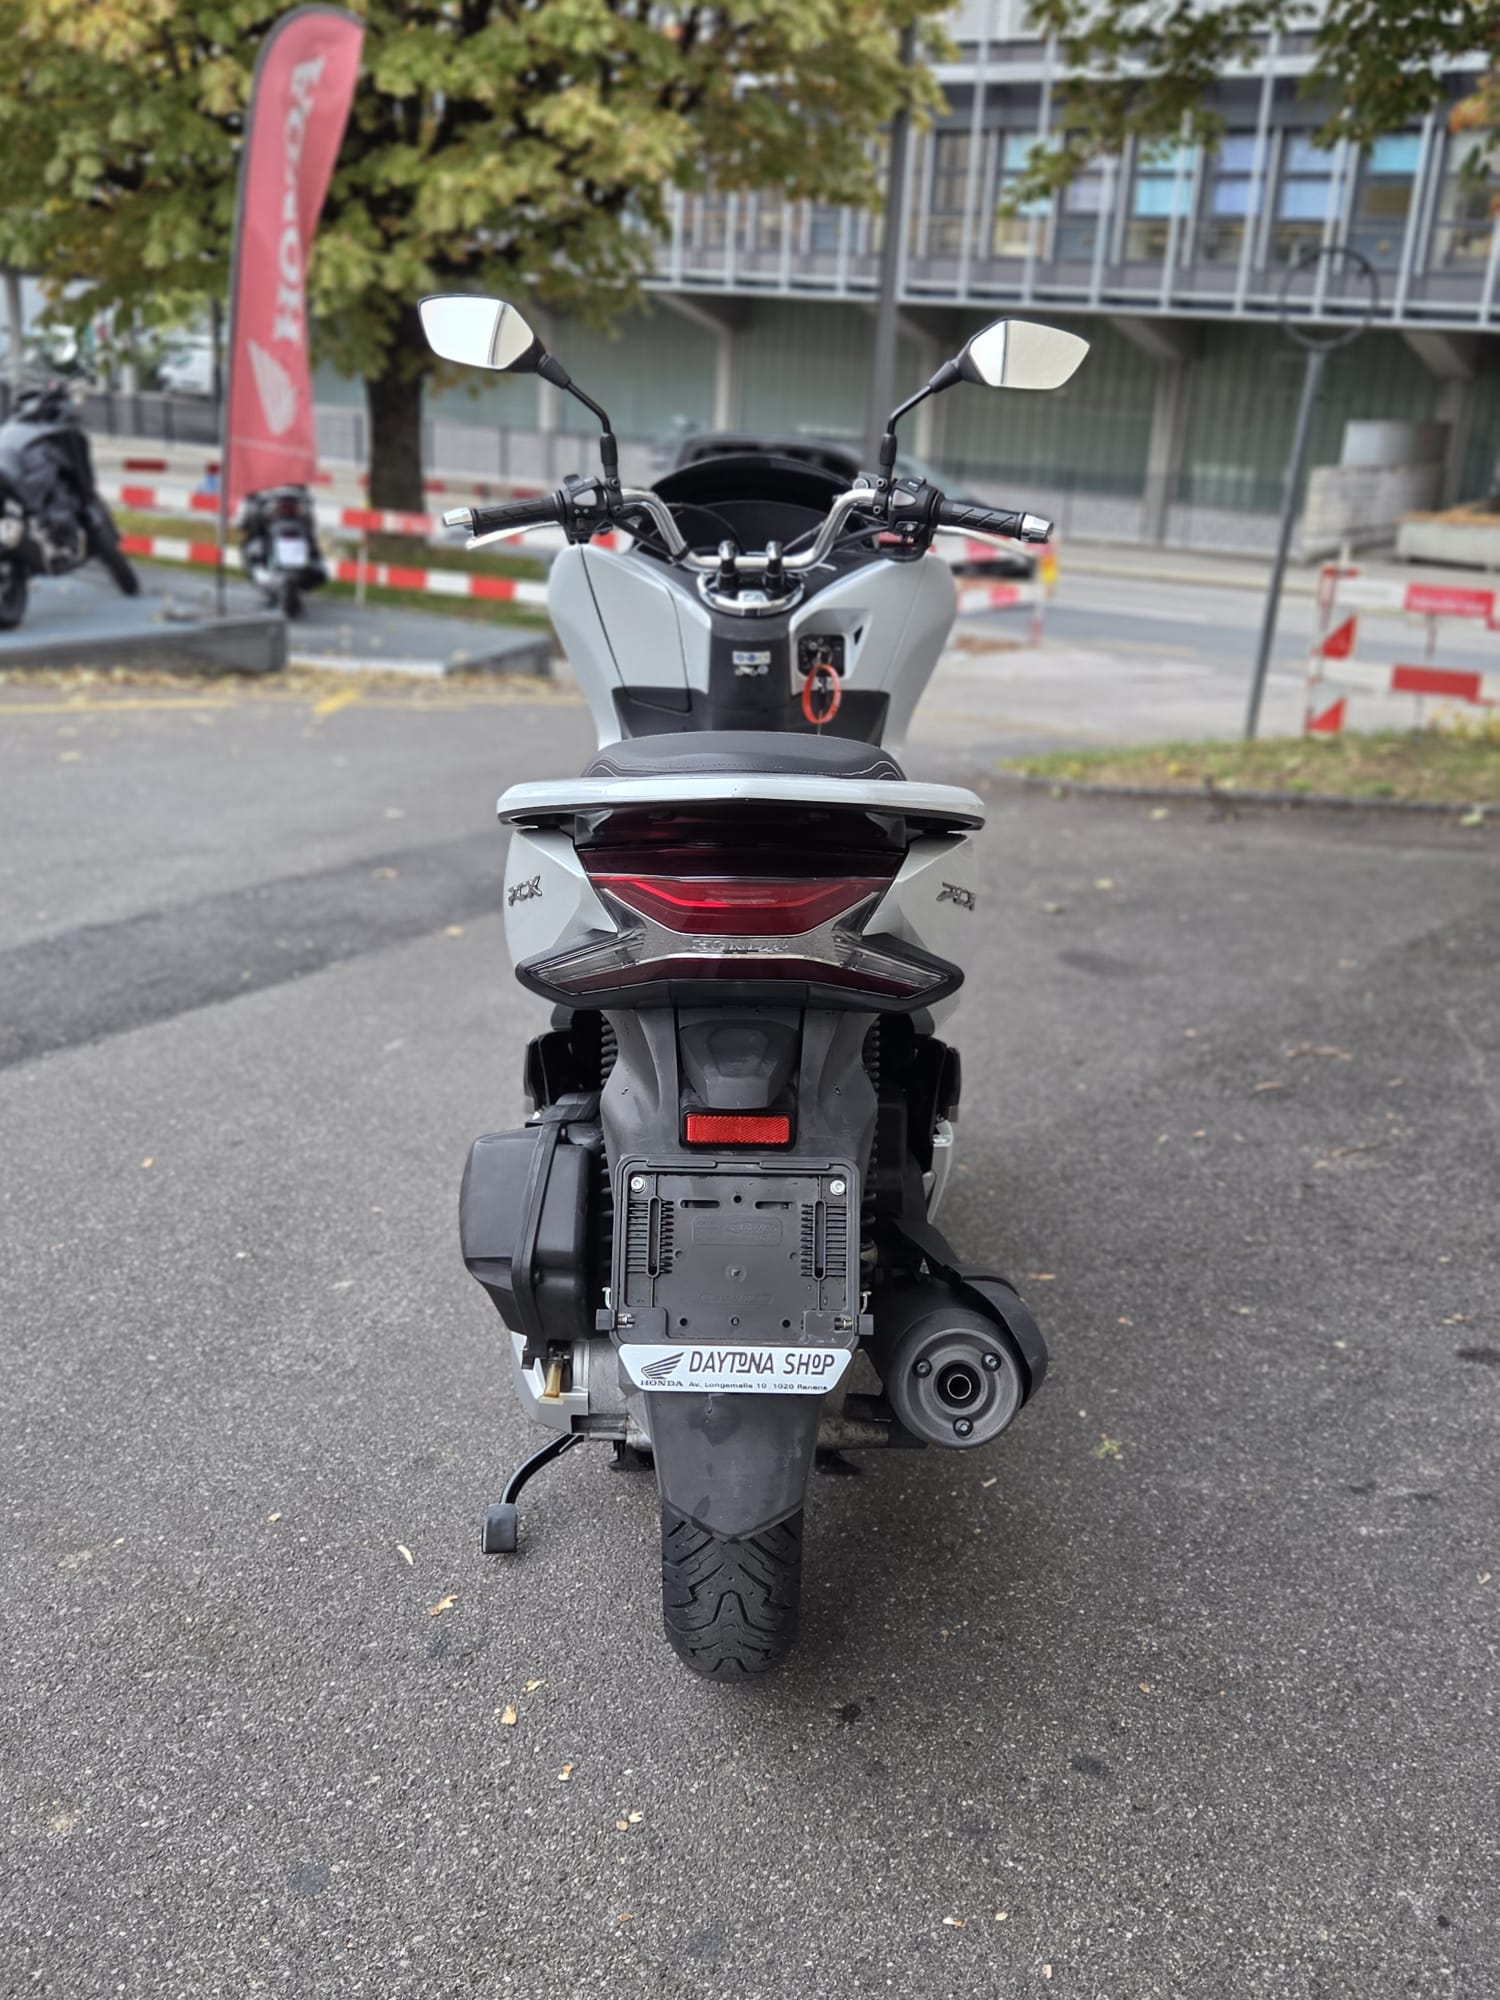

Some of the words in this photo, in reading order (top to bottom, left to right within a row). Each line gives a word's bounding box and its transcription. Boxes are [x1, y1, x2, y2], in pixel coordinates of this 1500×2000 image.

[689, 1351, 774, 1374] DAYTONA
[783, 1353, 835, 1375] SHOP
[640, 1379, 684, 1387] HONDA
